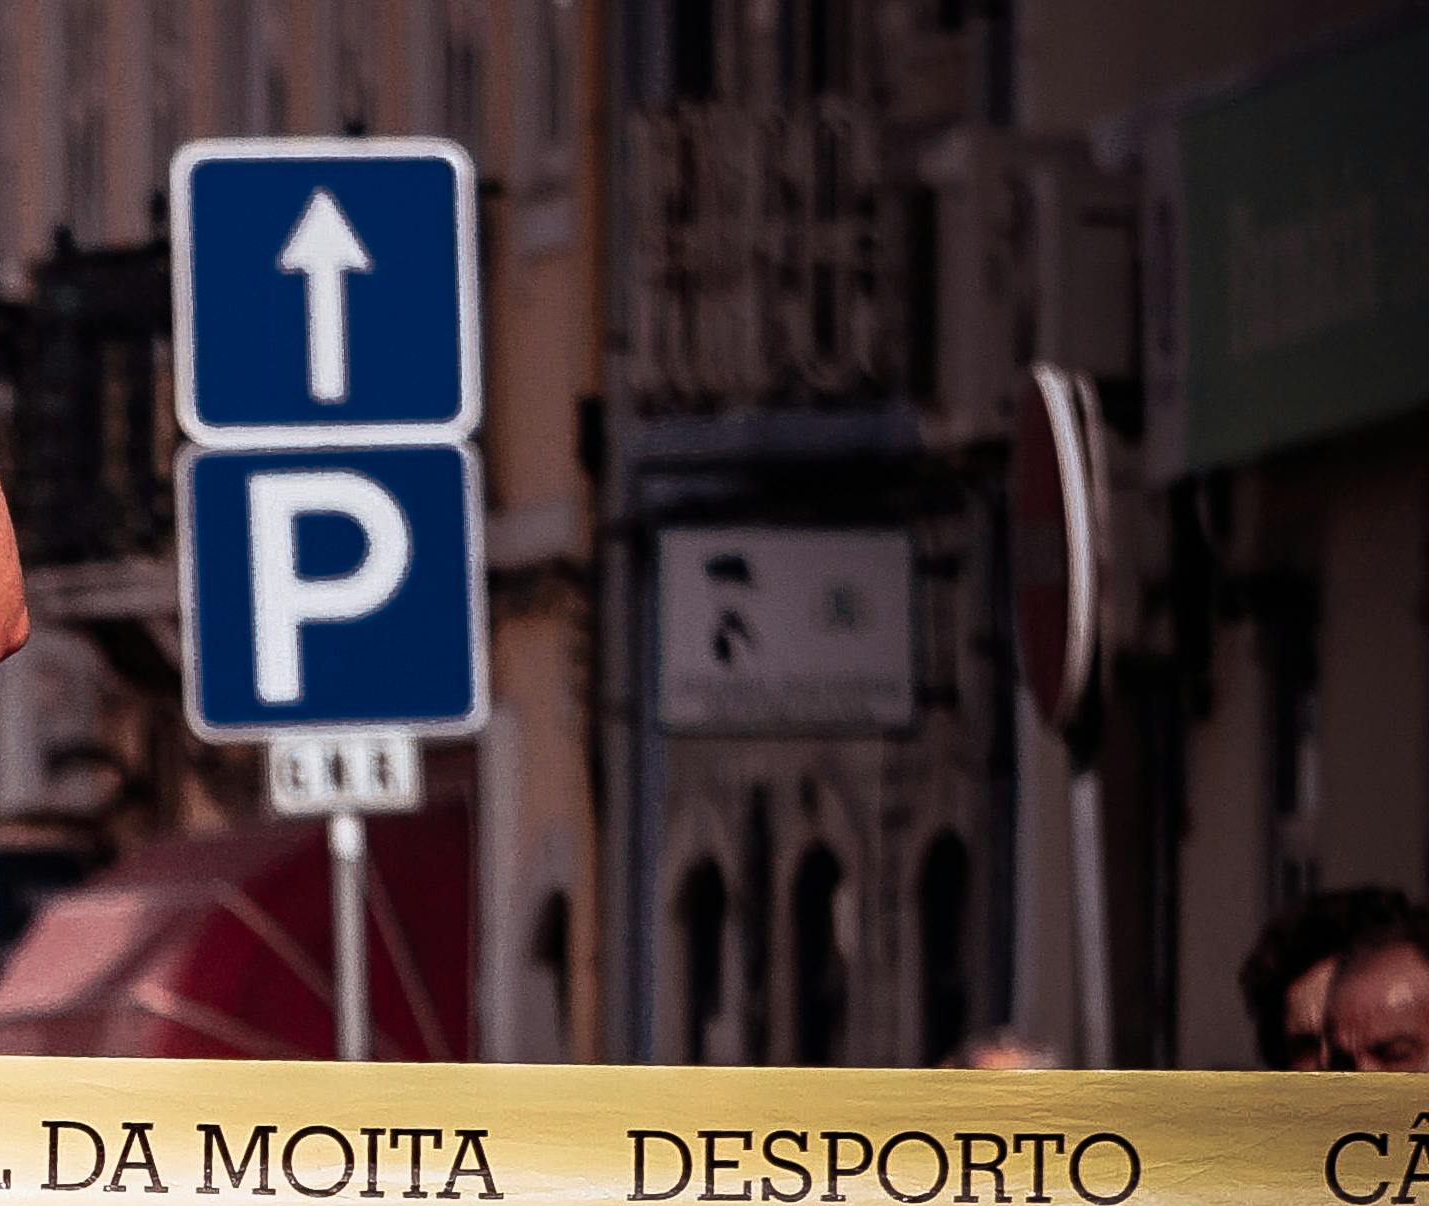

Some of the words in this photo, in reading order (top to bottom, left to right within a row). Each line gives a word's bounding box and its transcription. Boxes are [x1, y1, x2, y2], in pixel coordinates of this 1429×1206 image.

[249, 470, 410, 703] P
[41, 1120, 169, 1194] DA
[196, 1124, 504, 1200] MOITA
[627, 1129, 1142, 1206] DESPORTO
